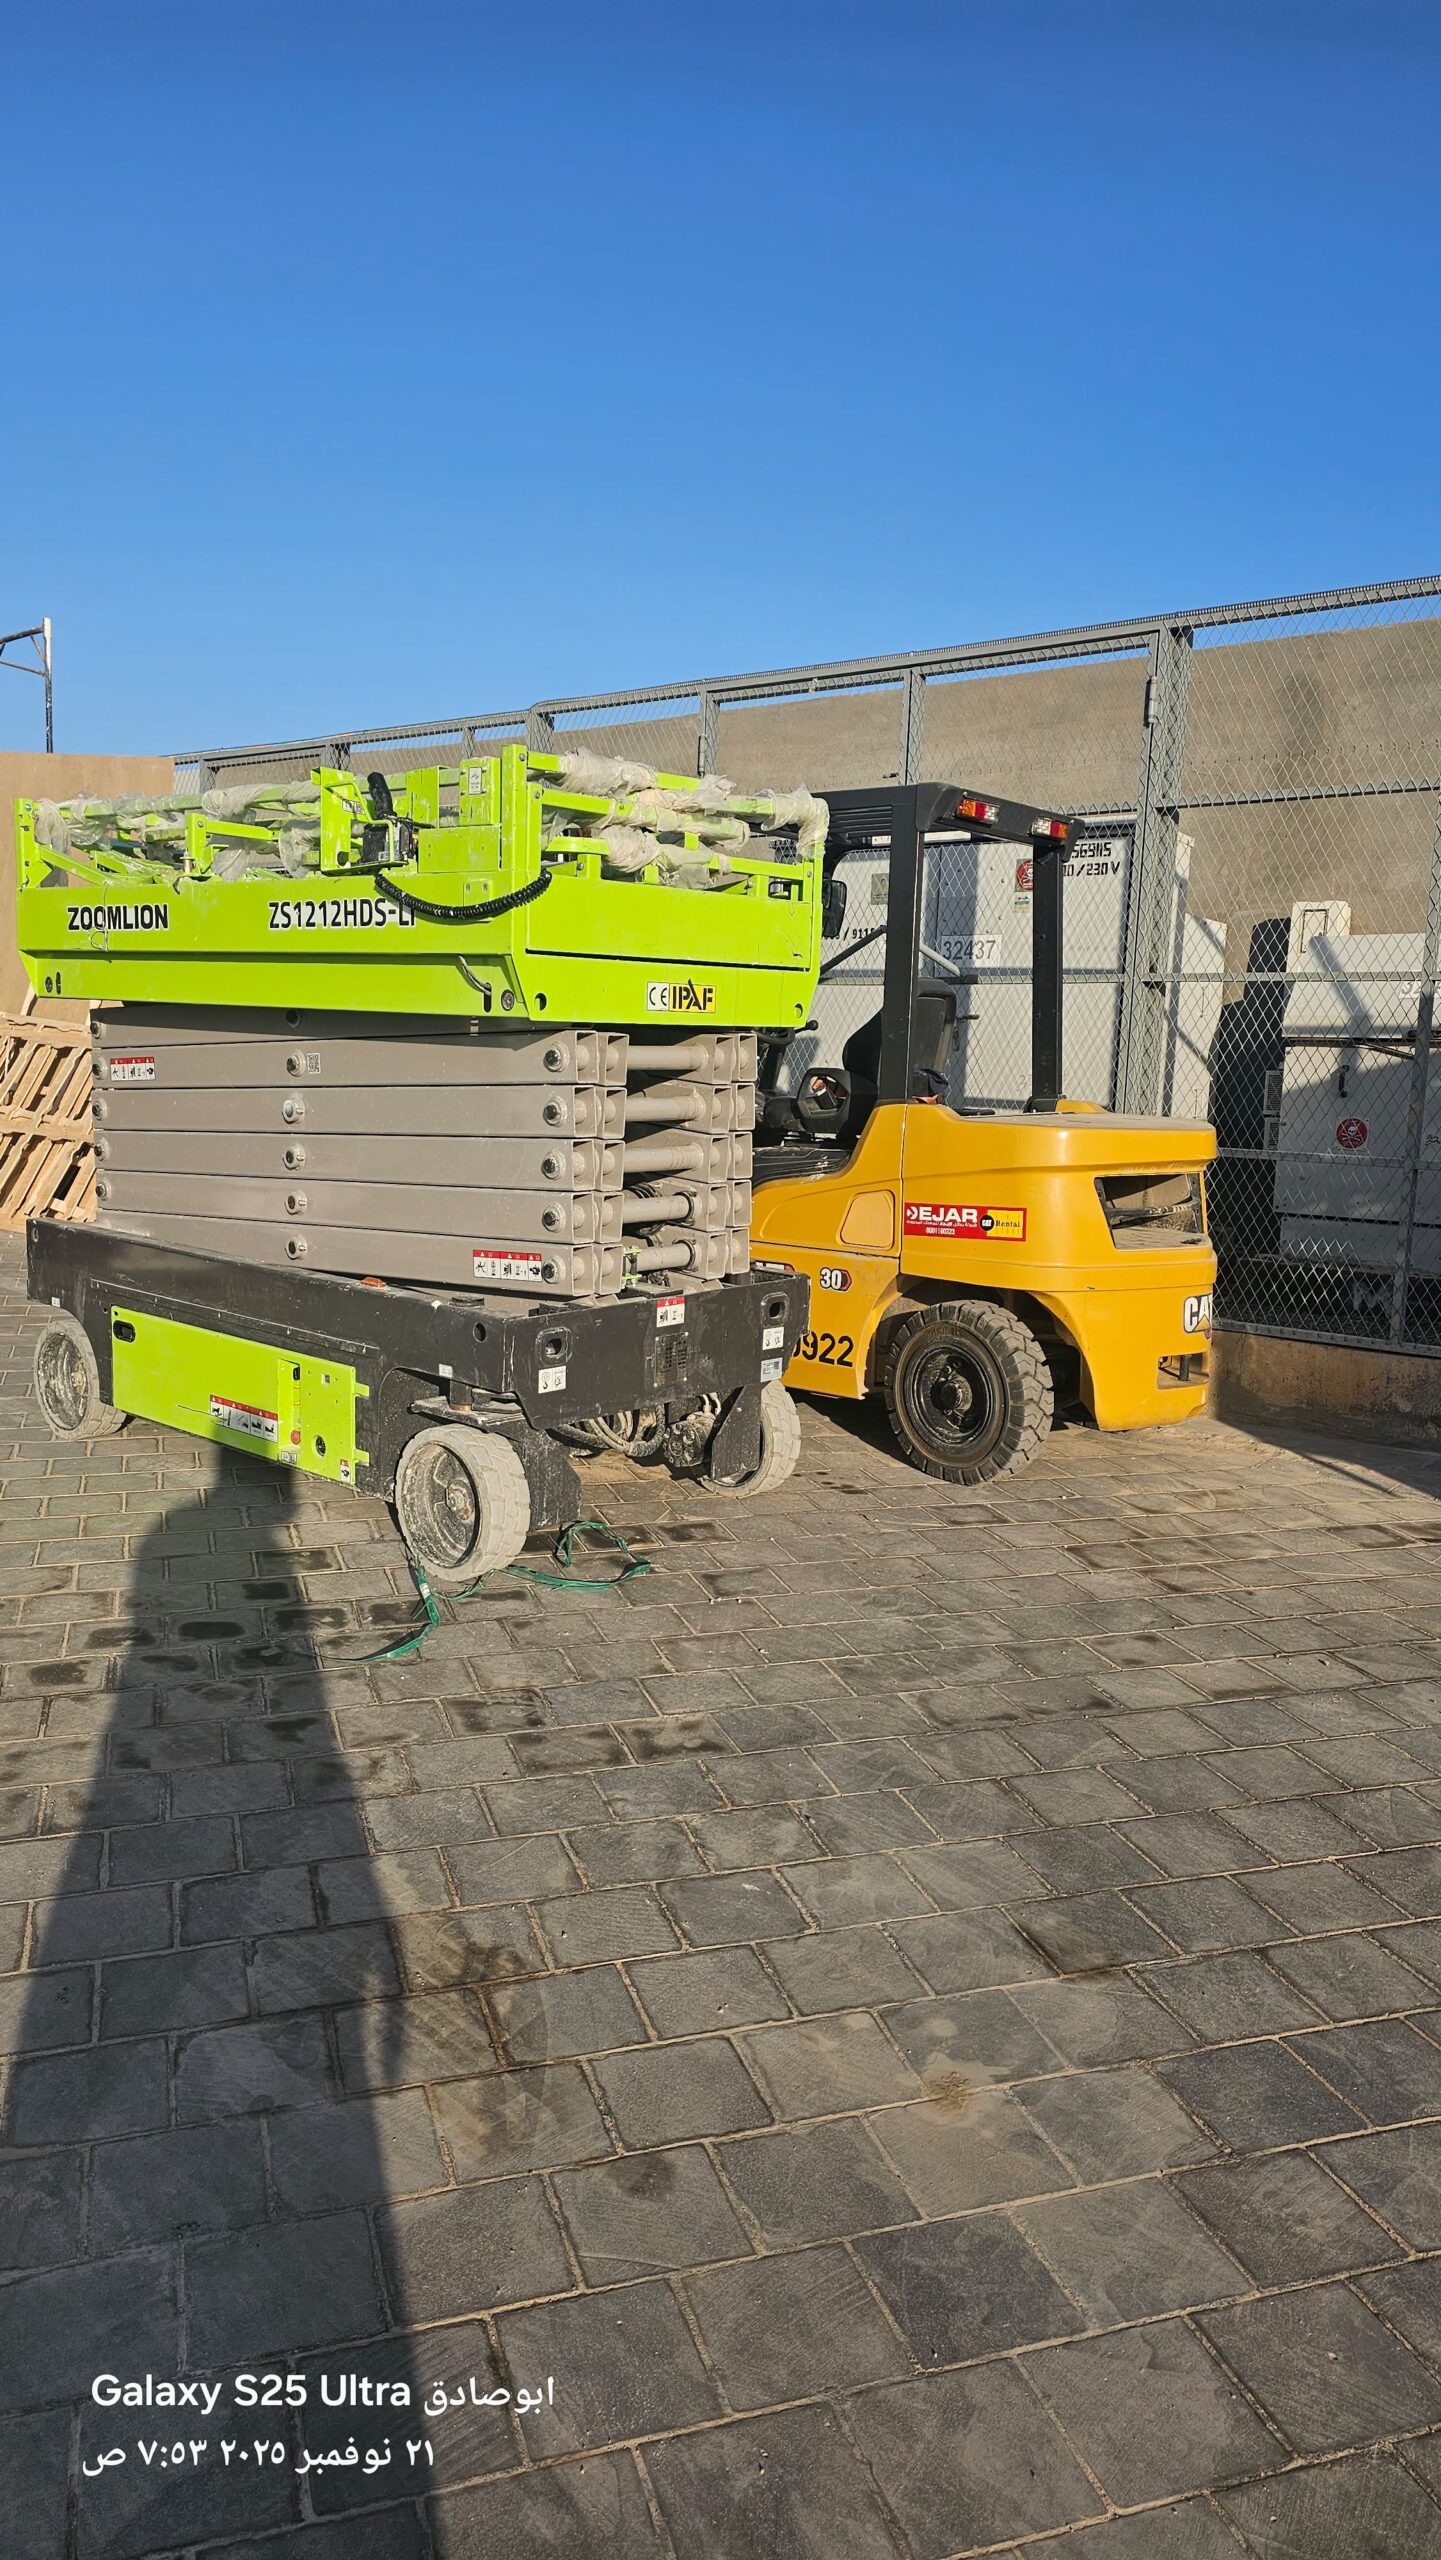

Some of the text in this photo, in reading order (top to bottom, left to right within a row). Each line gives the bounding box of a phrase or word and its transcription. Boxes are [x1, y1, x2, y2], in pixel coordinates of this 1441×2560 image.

[67, 904, 168, 930] ZOOMLION
[943, 940, 996, 960] 32437
[649, 978, 714, 1010] CE IPAF
[919, 1206, 978, 1223] EJAR
[995, 1220, 1020, 1229] Rental
[820, 1268, 842, 1290] 30
